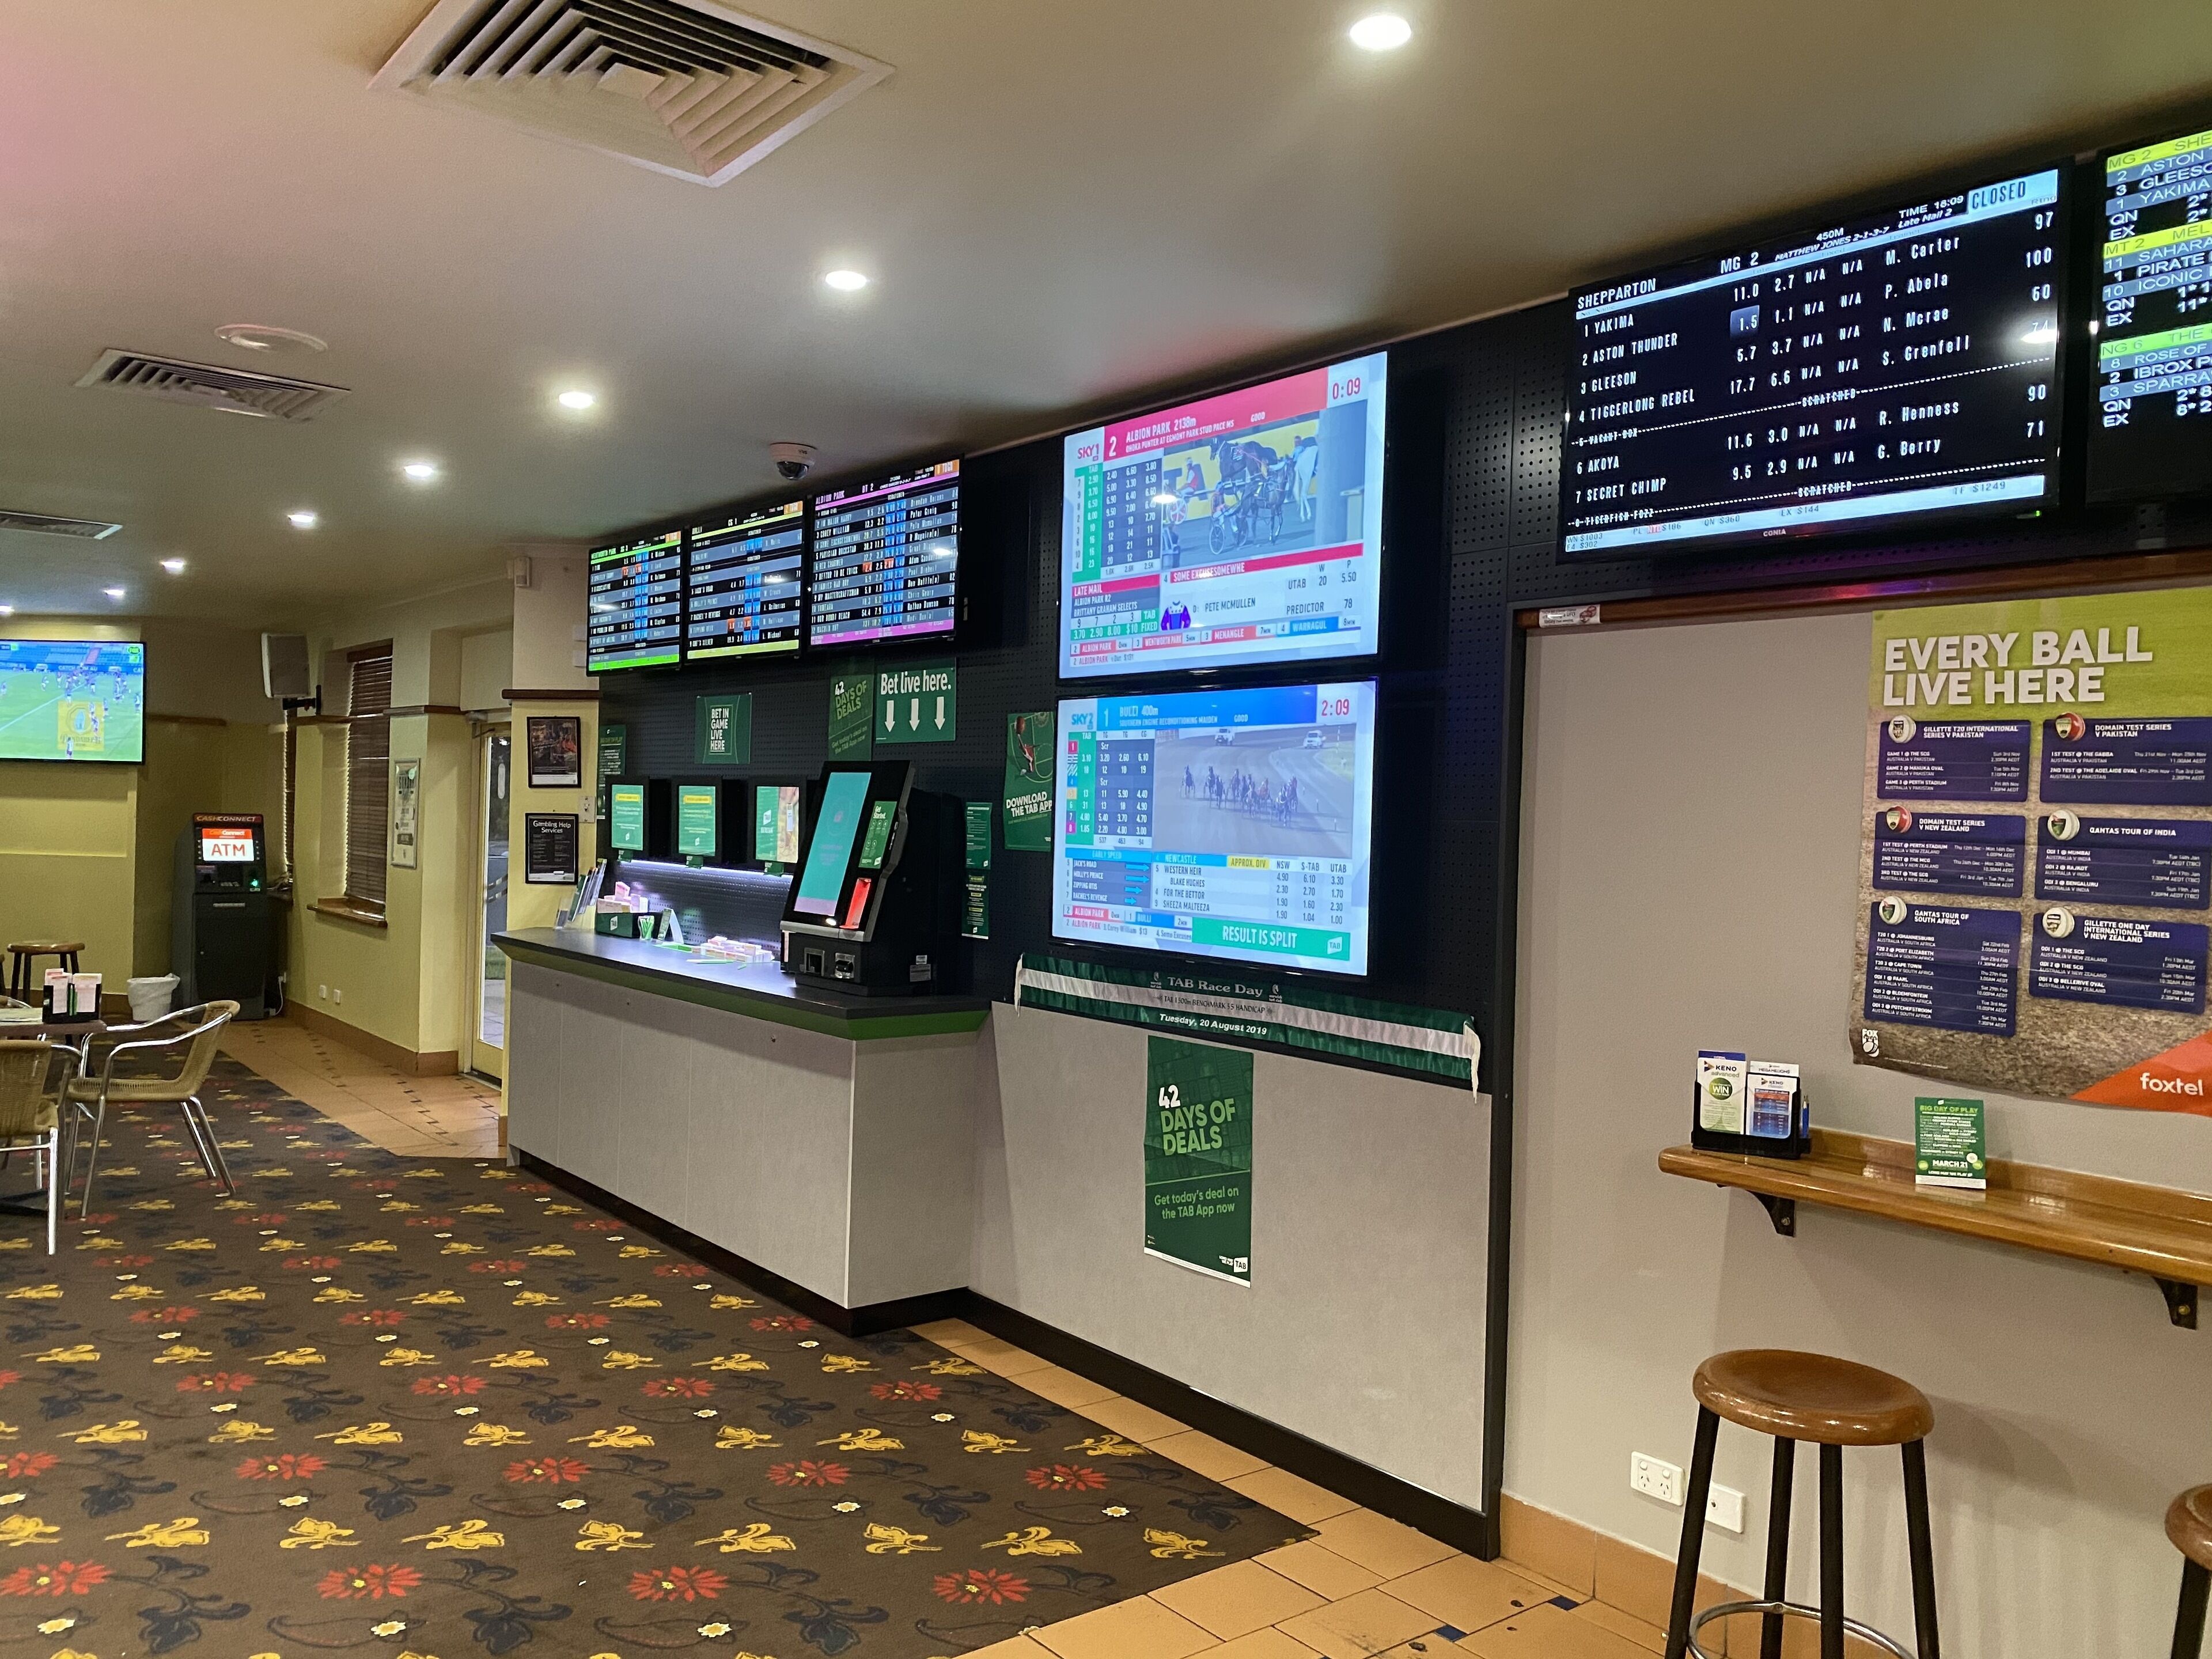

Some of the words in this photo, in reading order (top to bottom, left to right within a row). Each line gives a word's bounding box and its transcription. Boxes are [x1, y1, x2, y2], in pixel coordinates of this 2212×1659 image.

[2141, 150, 2203, 176] ASTON
[1972, 181, 2026, 210] CLOSED
[2140, 178, 2210, 204] YAKIMA
[1899, 204, 1928, 218] TIME
[1934, 196, 1964, 209] 18:09
[1898, 217, 1920, 228] Late
[1922, 210, 1942, 222] Mail
[1816, 228, 1843, 241] 450M
[1775, 244, 1820, 261] MATTHEW
[1820, 236, 1851, 249] JONES
[1594, 314, 1634, 334] YAKIMA
[1734, 283, 1759, 301] 11.0
[1911, 237, 1959, 259] Carter
[2035, 211, 2054, 230] 97
[2138, 252, 2205, 277] PIRATE
[1578, 278, 1656, 309] SHEPPARTON
[1721, 256, 1741, 274] MG
[2139, 269, 2203, 291] ICONIC
[1593, 344, 1624, 363] ASTON
[1632, 333, 1677, 354] THUNDER
[1740, 315, 1757, 331] 1.5
[1907, 273, 1948, 294] Abela
[2026, 247, 2052, 268] 100
[2169, 328, 2203, 342] THE
[1592, 371, 1636, 392] GLEESON
[1906, 308, 1948, 327] Mcrae
[2135, 348, 2179, 365] ROSE
[2184, 343, 2207, 355] OF
[1591, 397, 1654, 421] TIGGERLONG
[1662, 389, 1694, 407] REBEL
[1730, 377, 1755, 394] 17.7
[1904, 335, 1969, 361] Grenfell
[2134, 358, 2194, 379] IBROX
[1332, 377, 1360, 399] 0:09
[1251, 411, 1265, 422] GOOD
[1109, 436, 1116, 457] 2
[1126, 427, 1150, 443] ALBION
[1153, 422, 1171, 437] PARK
[1174, 416, 1196, 430] 2138m
[1588, 456, 1619, 472] AKOYA
[1728, 433, 1752, 450] 11.6
[1902, 402, 1959, 422] Henness
[2028, 384, 2046, 402] 90
[1587, 484, 1624, 502] SECRET
[1631, 478, 1666, 495] CHIMP
[1900, 439, 1941, 456] Berry
[1763, 529, 1786, 537] CONIA
[1074, 587, 1088, 596] LATE
[1088, 584, 1103, 594] MAIL
[1289, 578, 1306, 589] UTAB
[1342, 572, 1356, 583] 5.50
[1205, 601, 1219, 612] PETE
[1221, 597, 1256, 610] MCMULLEN
[1287, 602, 1324, 615] PREDICTOR
[1344, 599, 1352, 608] 78
[1885, 632, 2018, 671] EVERY
[2032, 627, 2153, 665] BALL
[835, 681, 844, 695] 42
[881, 673, 898, 695] Bet
[901, 671, 920, 694] live
[923, 670, 952, 691] here.
[1883, 669, 1971, 706] LIVE
[1984, 667, 2105, 704] HERE
[836, 688, 855, 708] DAYS
[856, 680, 867, 696] OF
[711, 709, 722, 718] BET
[723, 708, 729, 718] IN
[836, 697, 861, 719] DEALS
[1321, 699, 1349, 716] 2:09
[711, 719, 728, 729] GAME
[1234, 714, 1248, 722] GOOD
[711, 730, 722, 740] LIVE
[710, 740, 725, 750] HERE
[1006, 791, 1047, 808] DOWNLOAD
[1011, 806, 1024, 817] THE
[1025, 804, 1038, 814] TAB
[1040, 800, 1052, 811] APP
[211, 844, 245, 856] ATM
[1165, 854, 1196, 863] NEWCASTLE
[1277, 861, 1290, 869] NSW
[1301, 862, 1319, 871] S-TAB
[1331, 863, 1346, 873] UTAB
[1165, 865, 1188, 874] WESTERN
[1190, 867, 1202, 876] HEIR
[1171, 877, 1185, 885] BLAKE
[1186, 879, 1205, 887] HUGHES
[1164, 889, 1173, 897] FOR
[1185, 891, 1205, 899] BETTOR
[1163, 900, 1182, 909] SHEEZA
[1183, 902, 1210, 911] MALTEEZA
[1223, 926, 1256, 944] RESULT
[1259, 931, 1267, 945] IS
[1270, 931, 1297, 948] SPLIT
[2084, 926, 2142, 937] INTERNATIONAL
[2109, 935, 2143, 943] ZEALAND
[1168, 977, 1194, 988] TAB
[1198, 980, 1230, 993] Race
[1235, 984, 1263, 997] Day
[1192, 999, 1226, 1009] BENCHMARK
[1236, 1004, 1265, 1013] HANDICAP
[1160, 1014, 1197, 1027] Tuesday,
[1199, 1019, 1210, 1027] 20
[1211, 1021, 1244, 1032] August
[1246, 1025, 1267, 1035] 2019
[1862, 1028, 1878, 1037] FOX
[1713, 1085, 1729, 1094] WIN
[2140, 1073, 2203, 1096] foxtel
[1158, 1085, 1181, 1109] 42
[1161, 1104, 1207, 1132] DAYS
[1210, 1098, 1236, 1123] OF
[1163, 1126, 1222, 1156] DEALS
[1154, 1194, 1169, 1206] Get
[1172, 1190, 1203, 1205] today's
[1206, 1186, 1225, 1199] deal
[1228, 1187, 1238, 1196] on
[1162, 1208, 1175, 1219] the
[1179, 1207, 1193, 1217] TAB
[1196, 1205, 1214, 1218] App
[1217, 1203, 1235, 1213] now
[1236, 1260, 1246, 1269] TAB
